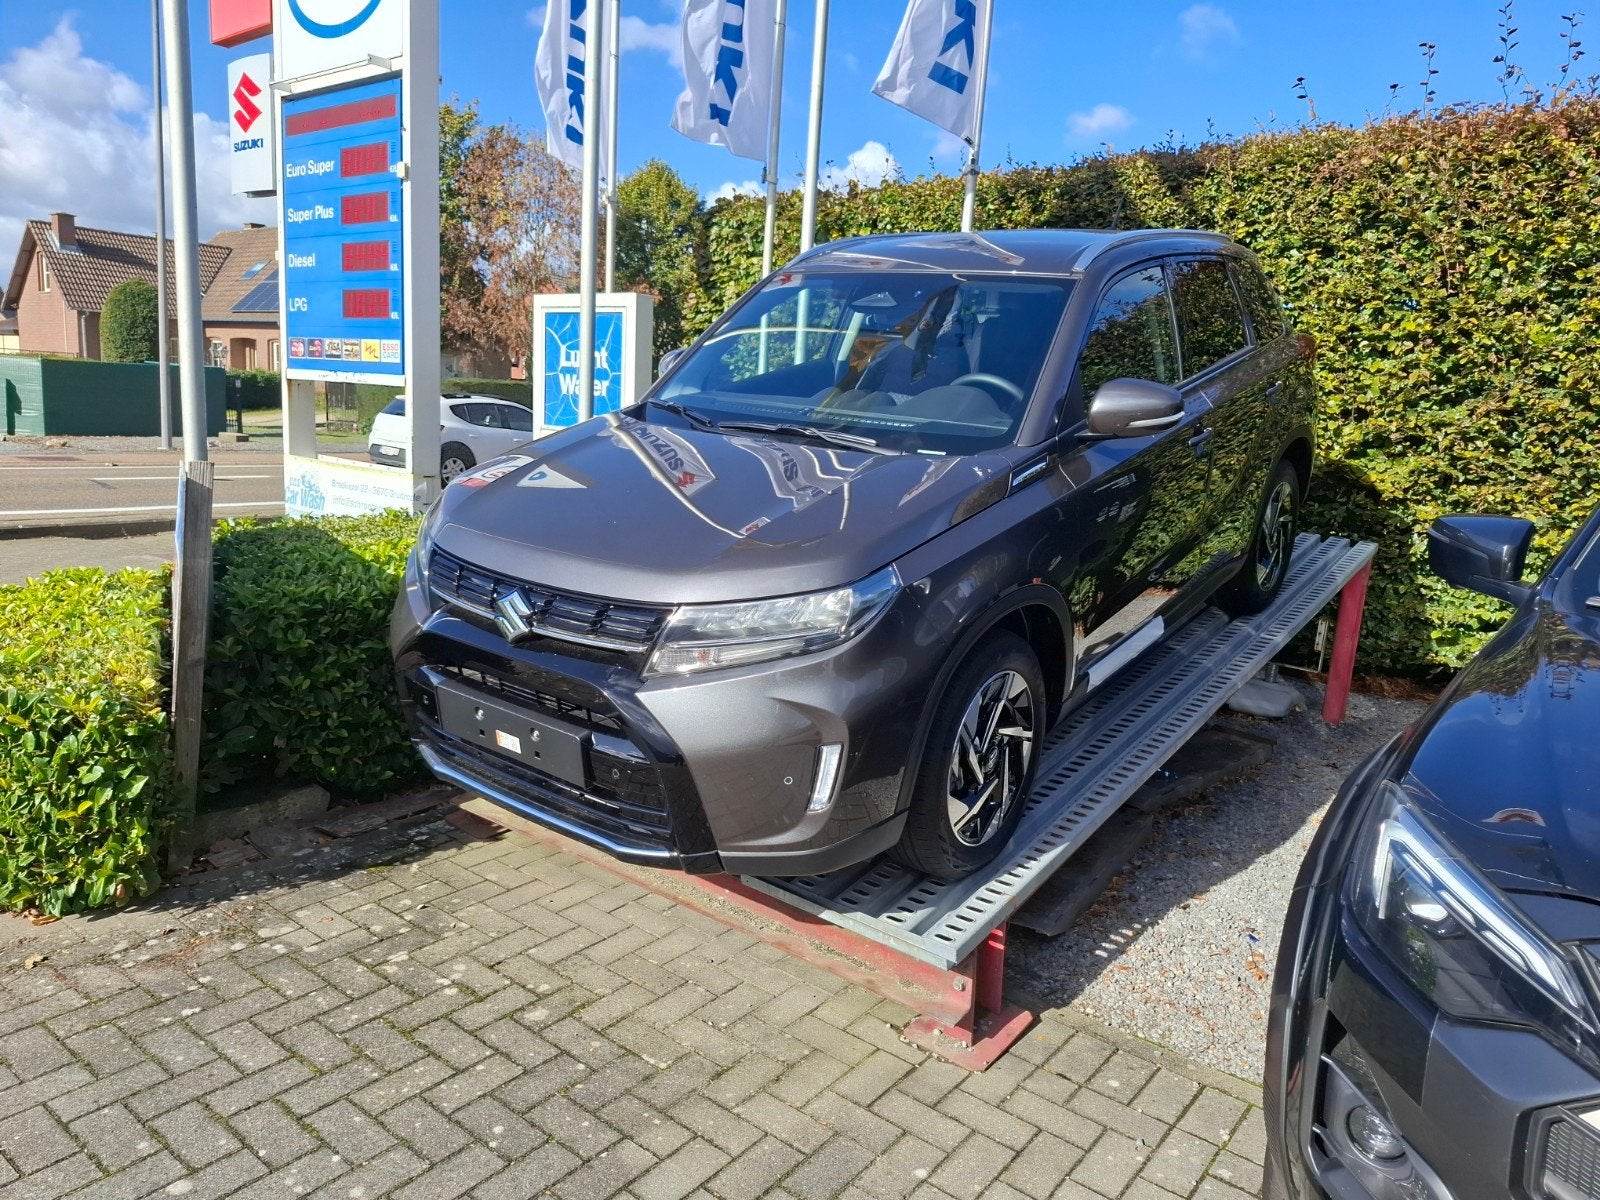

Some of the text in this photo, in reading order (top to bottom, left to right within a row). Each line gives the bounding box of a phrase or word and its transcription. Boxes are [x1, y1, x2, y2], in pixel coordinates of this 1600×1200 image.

[234, 138, 264, 152] SUZUKI
[286, 160, 335, 178] Euro Super
[287, 205, 334, 224] Super Plus
[288, 253, 315, 268] Diesel
[289, 297, 308, 312] LPG
[382, 343, 399, 351] ESSO
[382, 351, 399, 359] CARD
[560, 346, 608, 368] Lut
[560, 373, 610, 397] Waer
[285, 485, 325, 511] Car Wash
